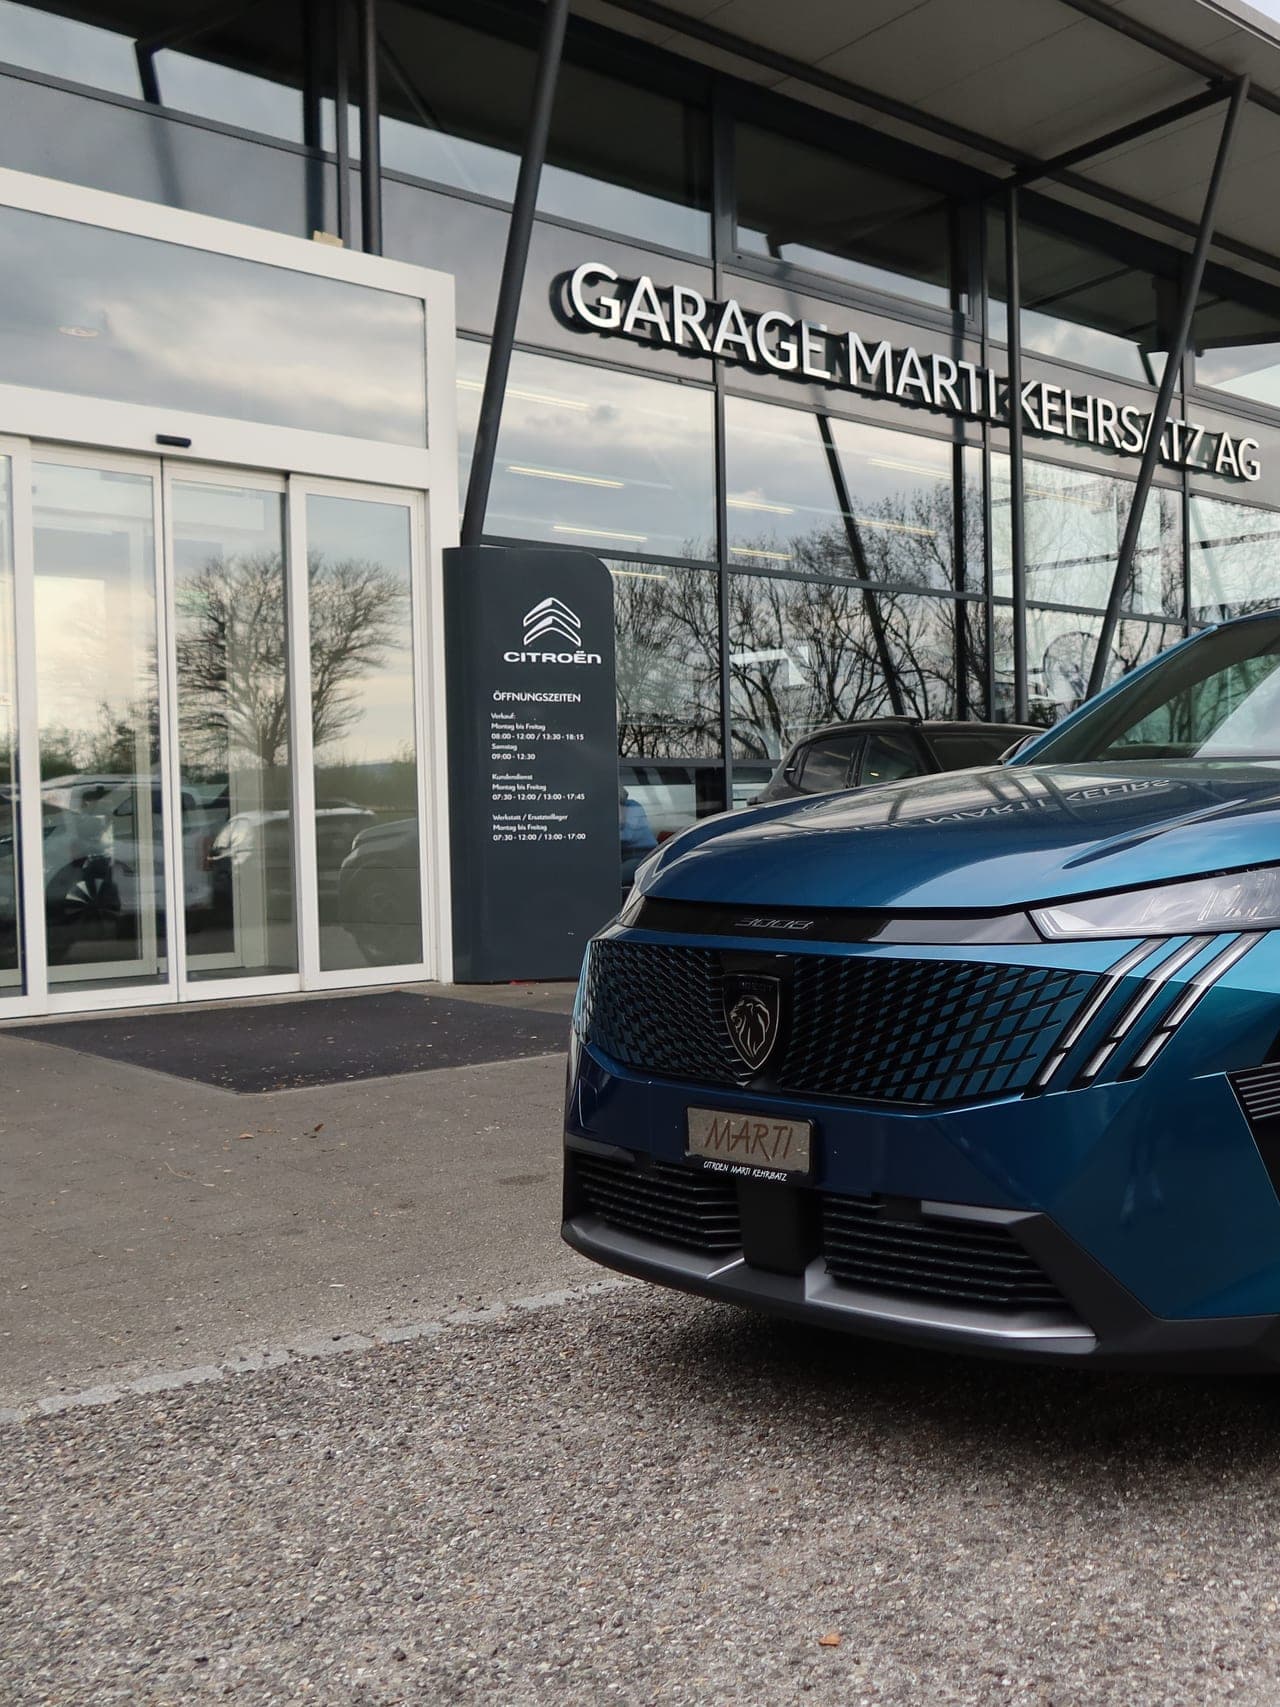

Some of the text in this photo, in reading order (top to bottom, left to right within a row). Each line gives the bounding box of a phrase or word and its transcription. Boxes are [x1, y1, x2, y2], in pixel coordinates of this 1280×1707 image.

[571, 262, 831, 380] GARAGE
[847, 330, 997, 418] MARTI
[1214, 431, 1262, 482] AG
[492, 689, 582, 703] ÖFFNUNGSZEITEN
[490, 722, 547, 732] Montag bis Freitag
[490, 732, 512, 741] 08:00
[516, 732, 536, 741] 12:00
[542, 733, 561, 741] 13:30
[565, 733, 585, 741] 18:15
[491, 742, 519, 752] Samstag
[491, 752, 513, 761] 09:00
[516, 753, 536, 761] 12:30
[491, 783, 548, 792] Montag bis Freitag
[491, 793, 513, 801] 07:30
[517, 793, 537, 801] 12:00
[543, 793, 562, 801] 13:00
[566, 793, 586, 801] 17:45
[492, 823, 548, 833] Montag bis Freitag
[492, 833, 514, 842] 07:30
[517, 833, 537, 841] 12:00
[544, 833, 563, 841] 13:00
[567, 832, 587, 841] 17:00
[703, 1117, 794, 1161] MARTI
[730, 1165, 751, 1177] MARTI
